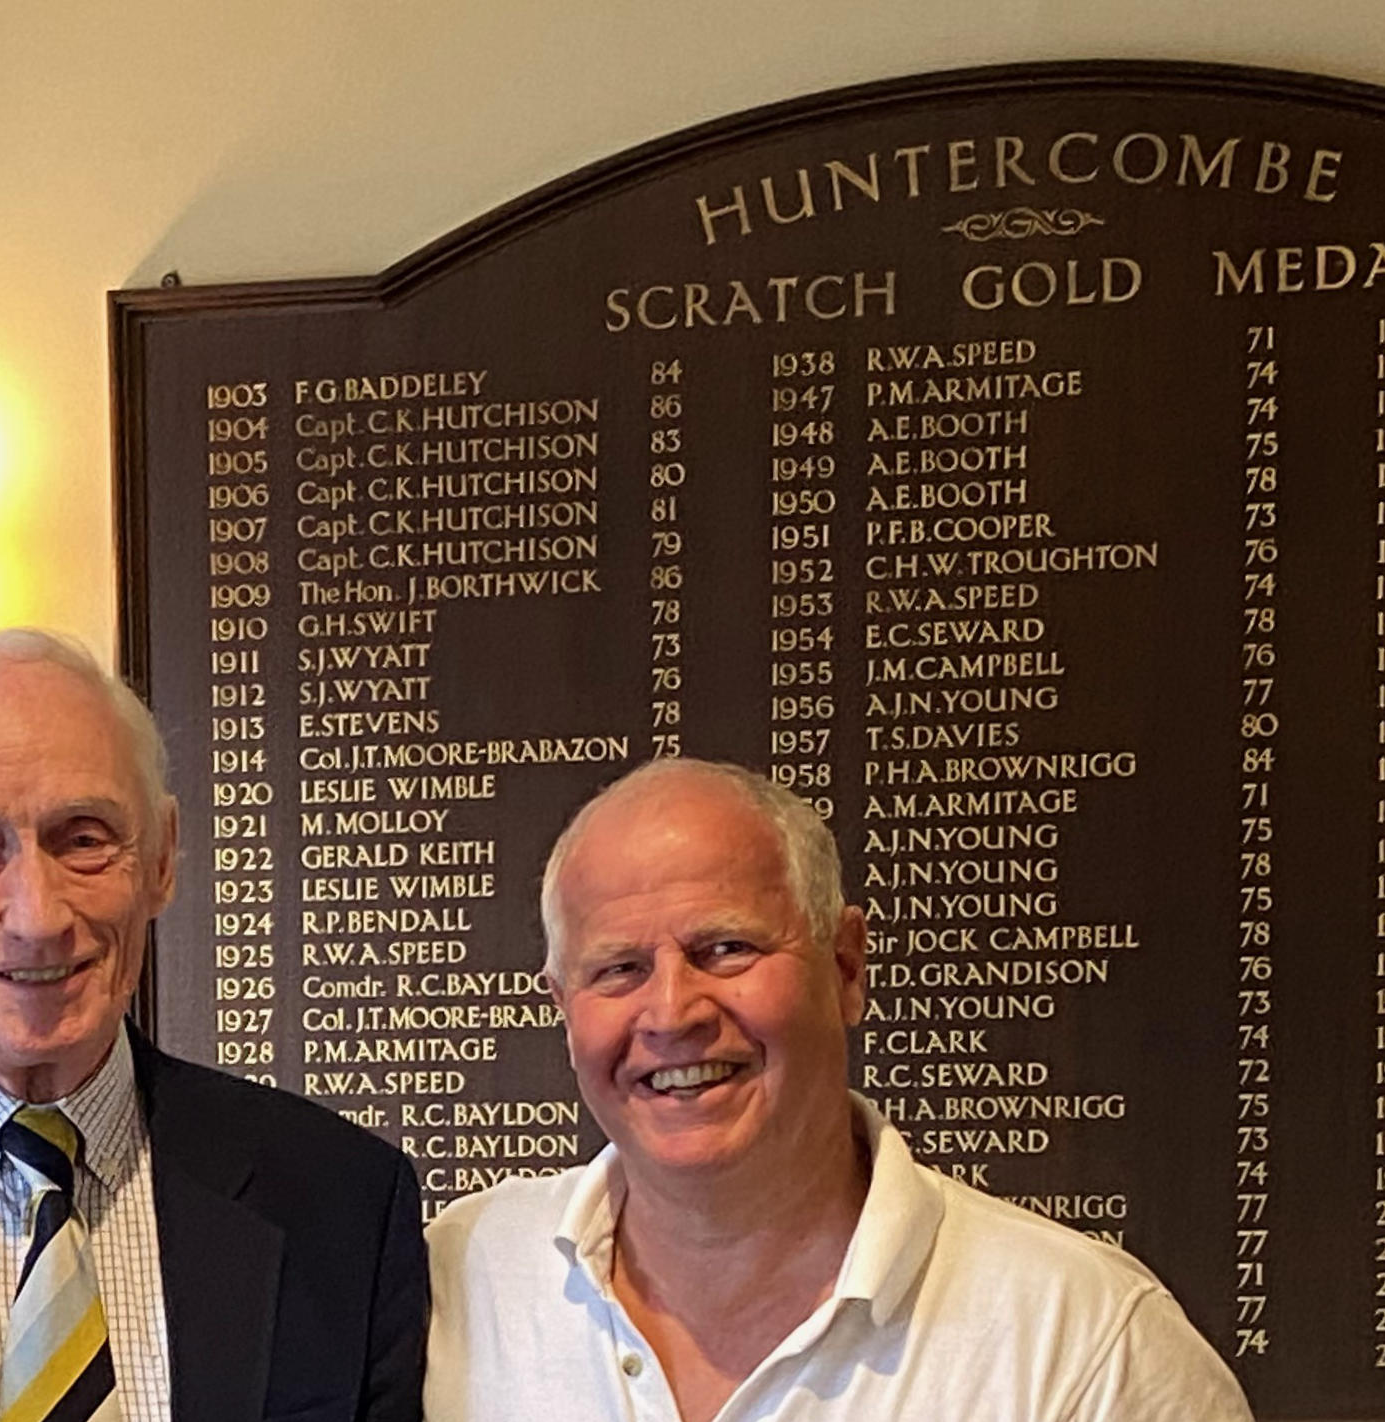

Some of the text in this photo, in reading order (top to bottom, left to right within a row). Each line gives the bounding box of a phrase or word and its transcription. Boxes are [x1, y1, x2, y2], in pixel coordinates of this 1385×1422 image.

[695, 131, 1343, 246] HUNTERCOMBE
[605, 242, 1385, 332] SCRATCH GOLD MEDA
[772, 350, 836, 378] 1938
[1246, 325, 1274, 354] 71
[207, 382, 268, 410] 1903
[650, 358, 683, 385] 84
[772, 384, 835, 414] 1947
[1246, 359, 1280, 390] 74
[207, 416, 270, 443] 1904
[650, 393, 683, 419] 86
[772, 420, 835, 448] 1948
[1246, 395, 1279, 426] 74
[208, 449, 269, 476] 1905
[650, 427, 682, 455] 83
[772, 454, 836, 483] 1949
[1245, 430, 1279, 461] 75
[208, 482, 270, 510] 1906
[649, 462, 687, 488] 80
[771, 488, 837, 517] 1950
[1245, 465, 1278, 496] 78
[209, 516, 269, 544] 1907
[650, 495, 677, 523] 81
[771, 523, 830, 551] 1951
[1244, 501, 1277, 532] 73
[209, 550, 270, 577] 1908
[651, 530, 683, 559] 79
[771, 558, 834, 585] 1952
[1244, 537, 1279, 568] 76
[210, 583, 272, 609] 1909
[298, 580, 341, 606] The
[649, 564, 684, 590] 86
[771, 591, 834, 619] 1953
[1244, 572, 1277, 601] 74
[210, 616, 269, 642] 1910
[651, 599, 681, 626] 78
[771, 625, 835, 653] 1954
[1243, 607, 1276, 635] 78
[211, 649, 260, 675] 1911
[651, 632, 682, 662] 73
[771, 660, 834, 687] 1955
[1242, 642, 1276, 671] 76
[211, 682, 267, 709] 1912
[651, 666, 682, 693] 76
[771, 694, 835, 721] 1956
[1242, 677, 1274, 706] 77
[211, 715, 266, 742] 1913
[651, 700, 681, 729] 78
[771, 728, 832, 757] 1957
[1240, 712, 1280, 739] 80
[212, 748, 270, 774] 1914
[650, 734, 681, 761] 75
[771, 762, 832, 789] 1958
[1242, 746, 1276, 773] 84
[213, 773, 496, 808] 1920 LESLIE WIMBLE
[1241, 781, 1269, 810] 71
[213, 813, 268, 840] 1921
[1241, 816, 1273, 845] 75
[214, 840, 496, 872] 1922 GERALD KEITH
[1240, 851, 1272, 881] 78
[214, 872, 496, 905] 1923 LESLIE WIMBLE
[1239, 885, 1273, 914] 75
[214, 908, 276, 937] 1924
[866, 920, 1271, 958] Sir JOCK CAMPBELL 78
[215, 942, 275, 969] 1925
[1239, 955, 1273, 983] 76
[215, 973, 277, 1001] 1926
[1237, 989, 1272, 1017] 73
[216, 1004, 275, 1036] 1927
[1238, 1024, 1270, 1051] 74
[216, 1040, 275, 1066] 1928
[1238, 1058, 1271, 1086] 72
[1237, 1092, 1270, 1121] 75
[1236, 1125, 1269, 1155] 73
[1236, 1160, 1269, 1188] 74
[1236, 1192, 1269, 1224] 77
[1236, 1228, 1270, 1258] 77
[1236, 1261, 1264, 1290] 71
[1236, 1295, 1267, 1325] 77
[1234, 1328, 1270, 1358] 74
